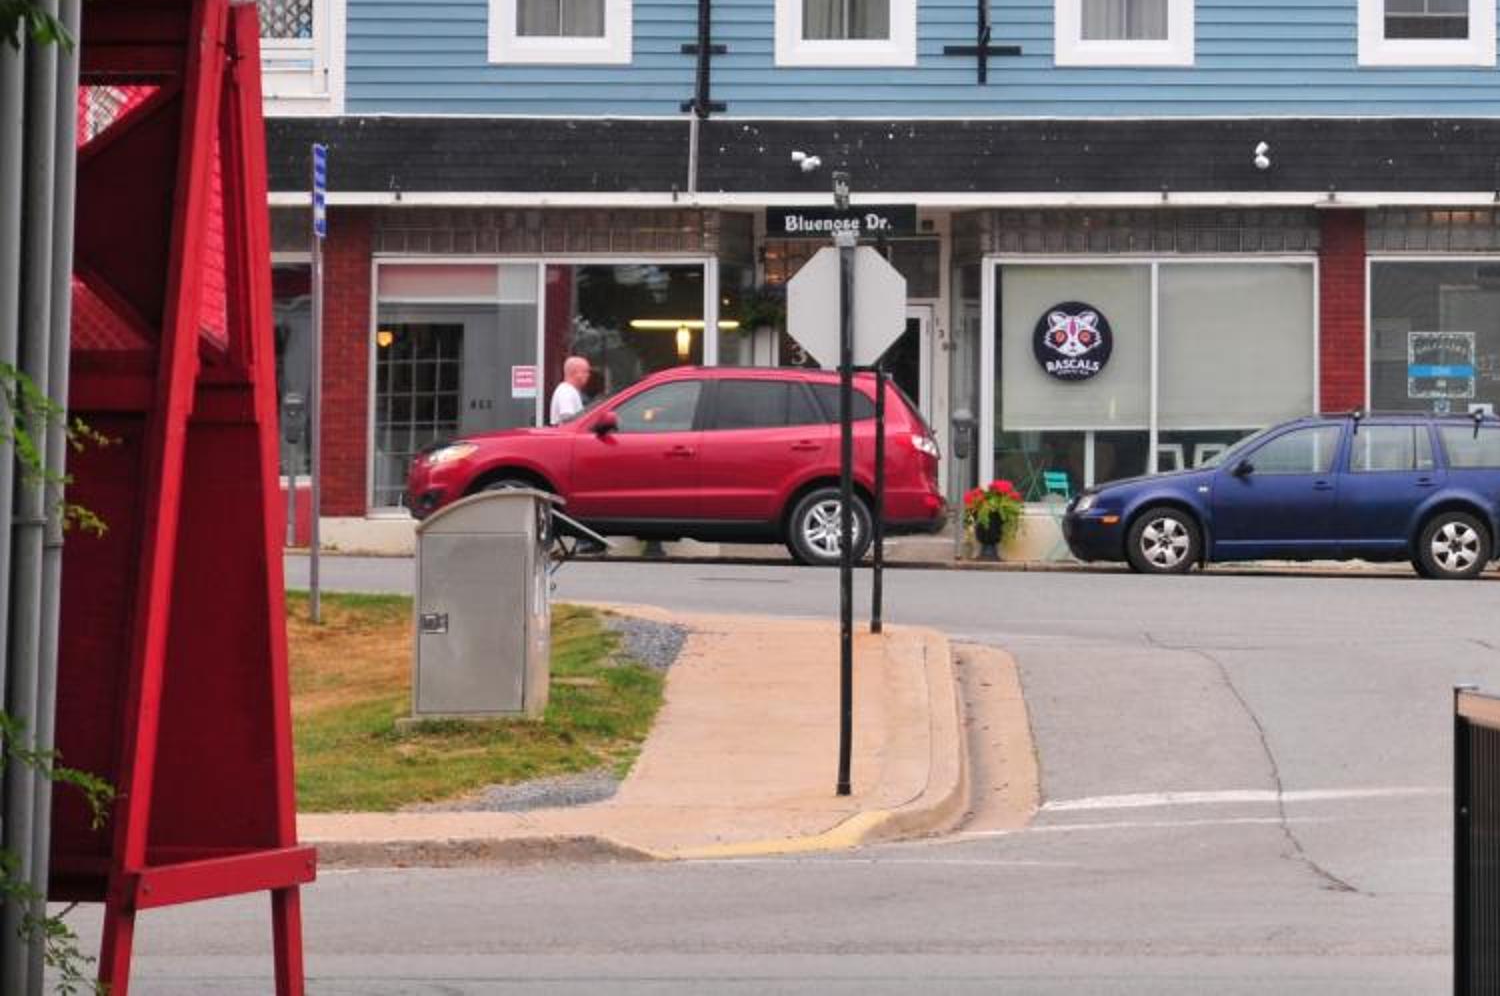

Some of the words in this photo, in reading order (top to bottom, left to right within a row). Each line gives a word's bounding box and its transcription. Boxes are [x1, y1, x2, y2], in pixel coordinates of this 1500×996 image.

[784, 214, 861, 232] Bluenose
[864, 213, 893, 231] Dr.
[1046, 359, 1100, 372] RASCALS
